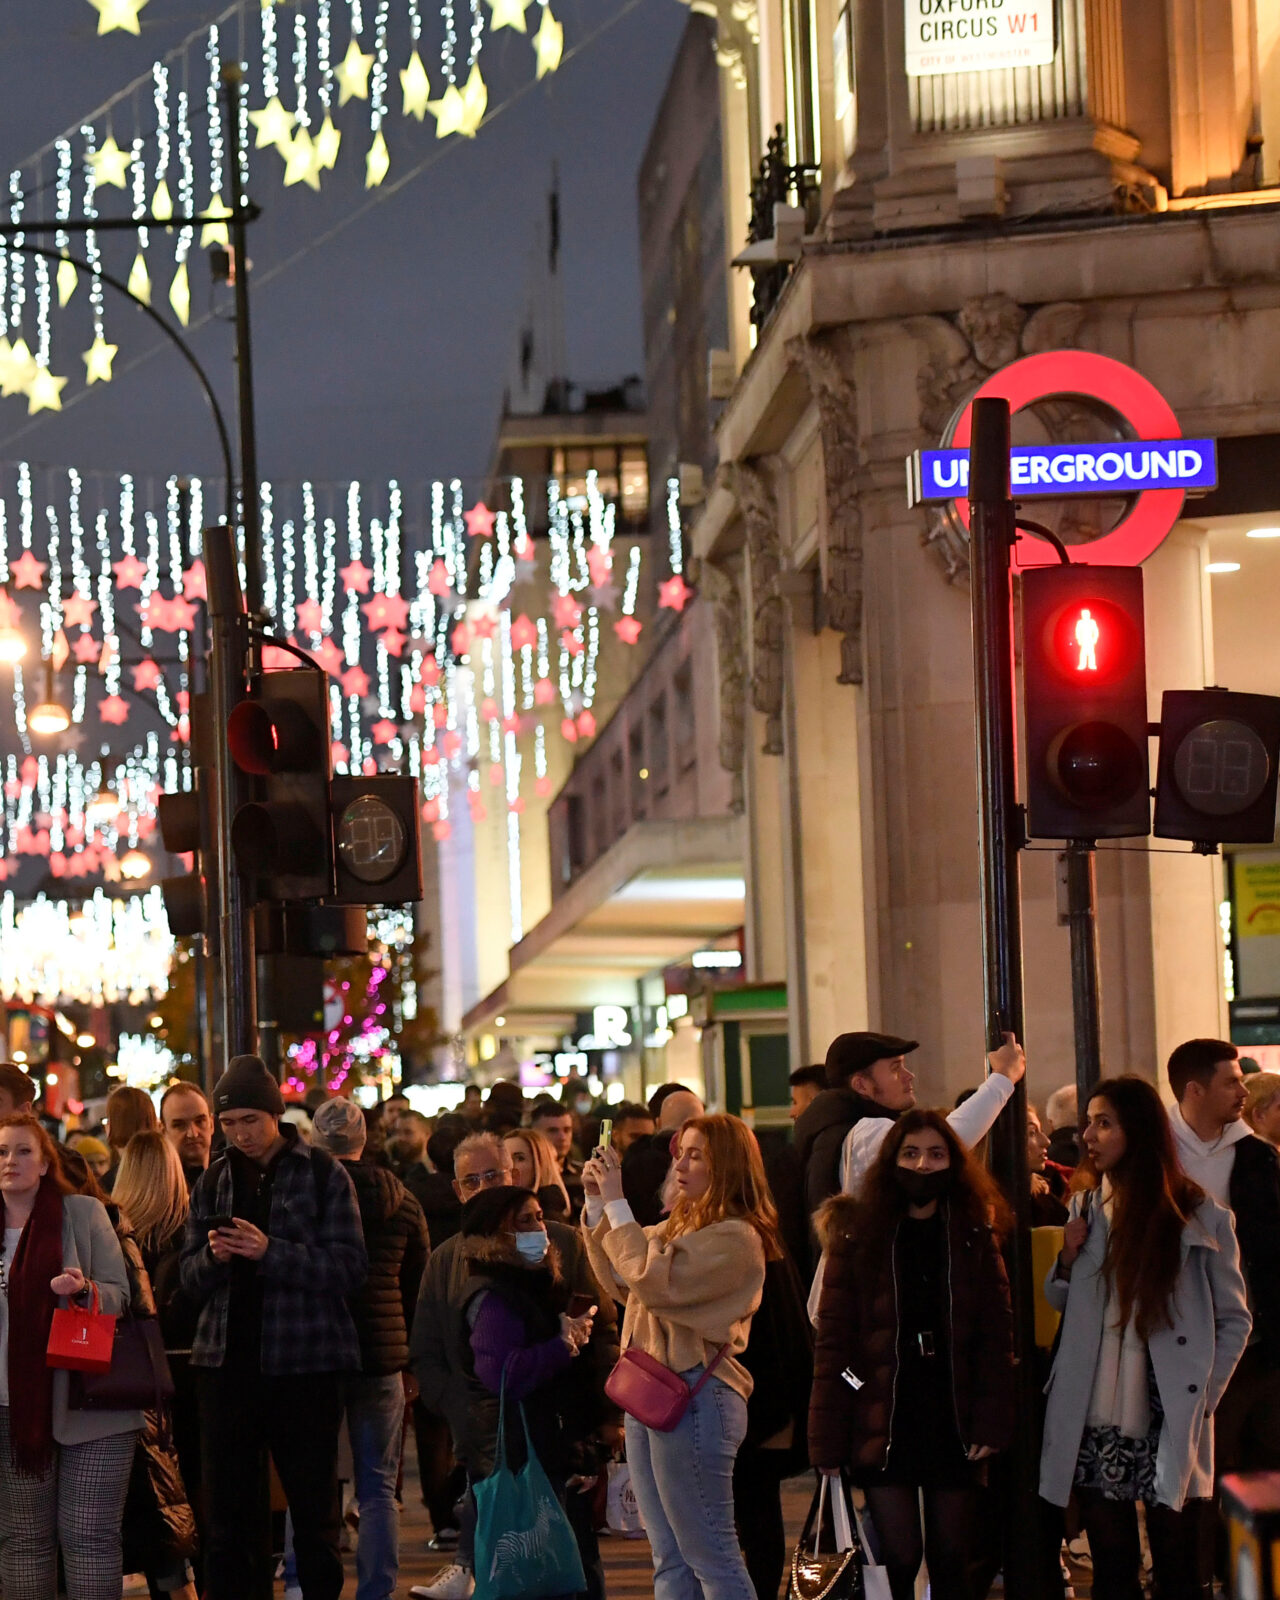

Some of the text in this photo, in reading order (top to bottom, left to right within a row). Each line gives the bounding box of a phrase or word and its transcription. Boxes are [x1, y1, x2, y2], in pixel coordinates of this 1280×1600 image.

[920, 12, 1038, 42] CIRCUS W1
[920, 55, 941, 67] CITY
[933, 449, 1203, 489] UERGROUND
